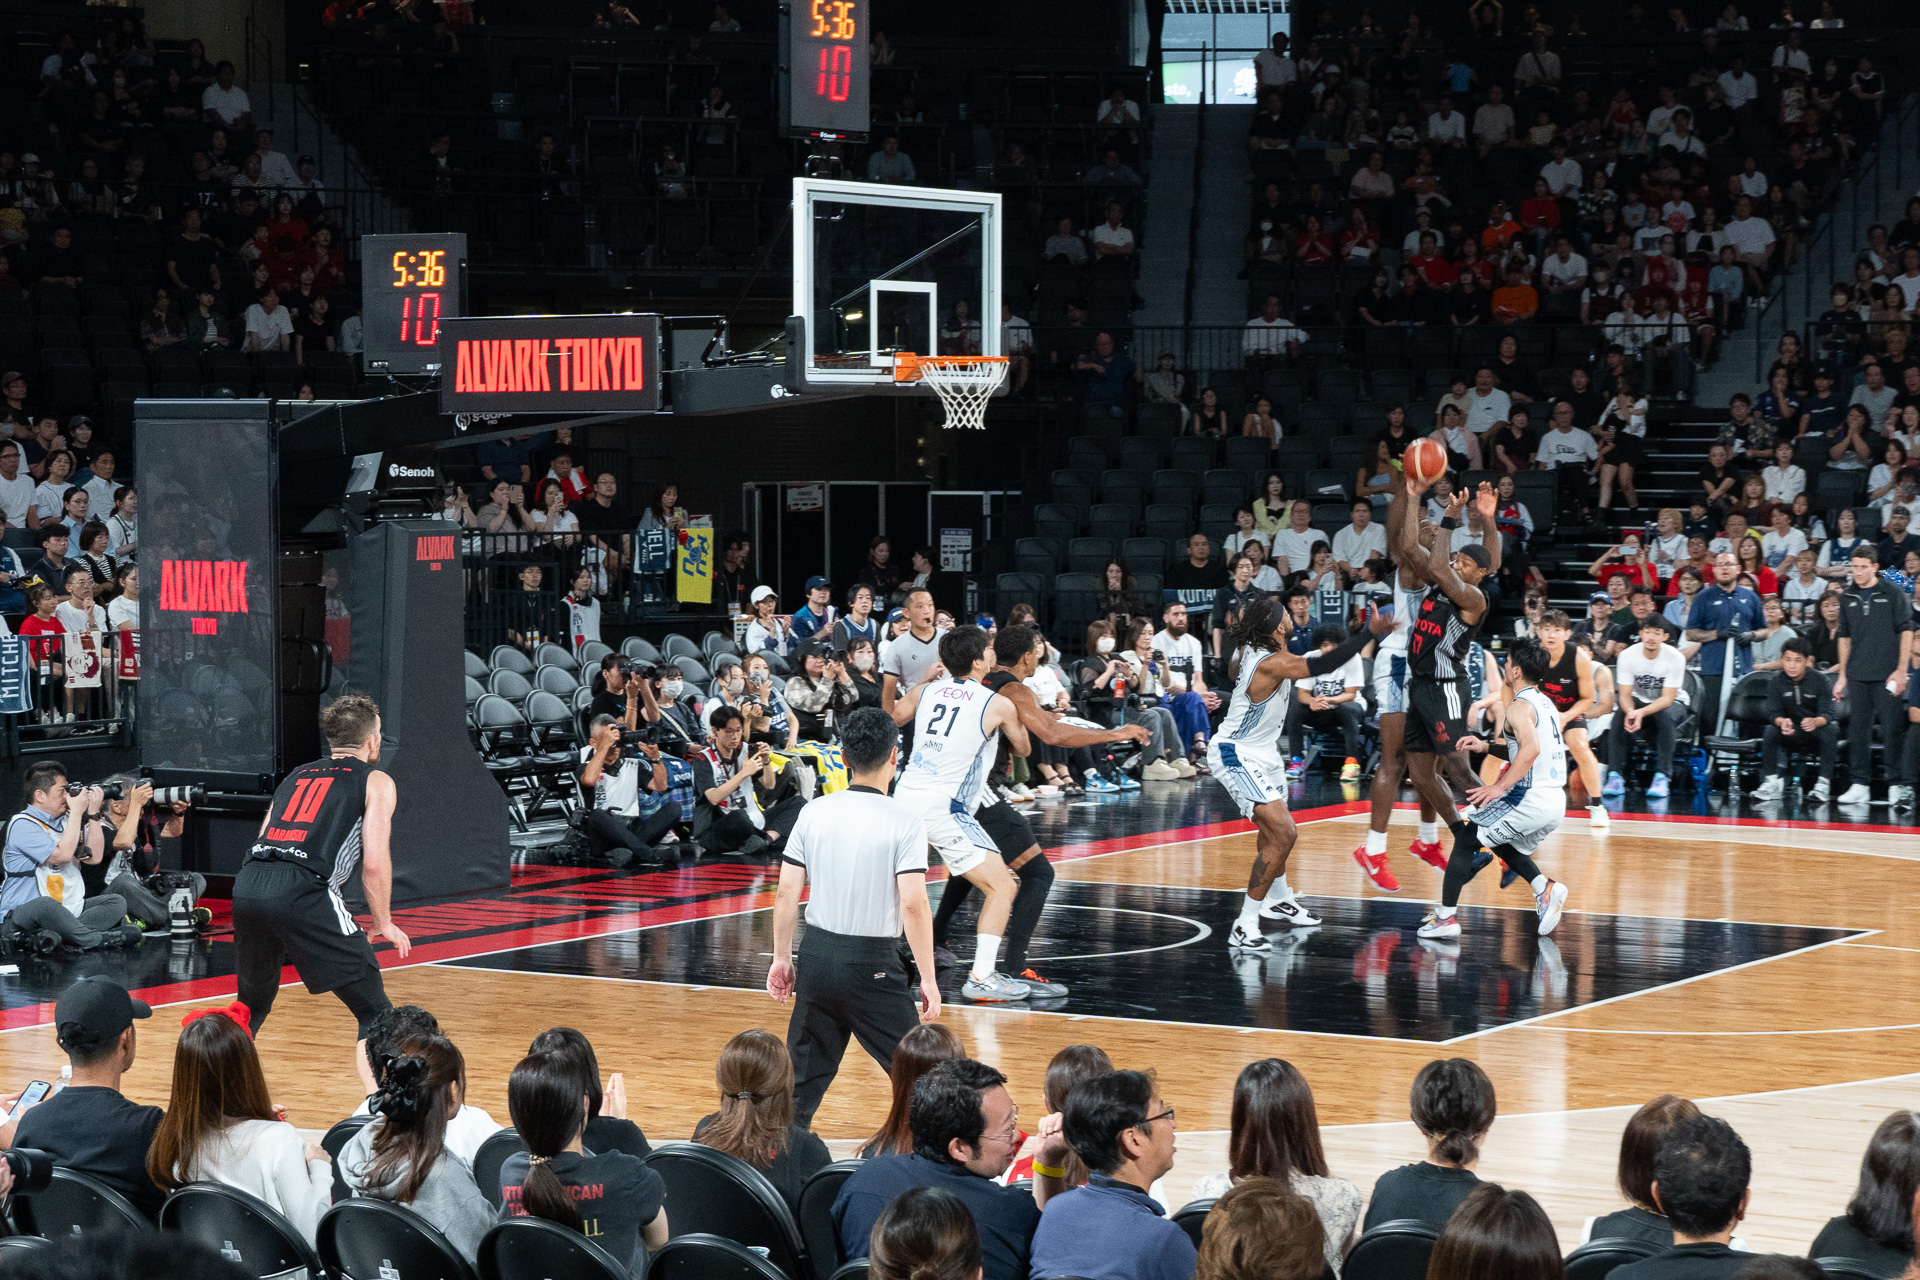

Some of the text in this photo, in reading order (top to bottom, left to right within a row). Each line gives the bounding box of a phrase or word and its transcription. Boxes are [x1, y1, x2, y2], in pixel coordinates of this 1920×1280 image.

[811, 0, 855, 40] 5:36
[818, 45, 851, 101] 10
[393, 250, 446, 287] 5:36
[400, 293, 440, 346] 10
[455, 336, 643, 393] ALVARK TOKYO
[399, 465, 435, 477] Senoh
[416, 535, 455, 561] ALVARK
[159, 559, 249, 614] ALVARK
[190, 617, 218, 636] TOKYO
[925, 703, 961, 737] 21
[1550, 715, 1561, 745] 4
[280, 777, 335, 824] 10
